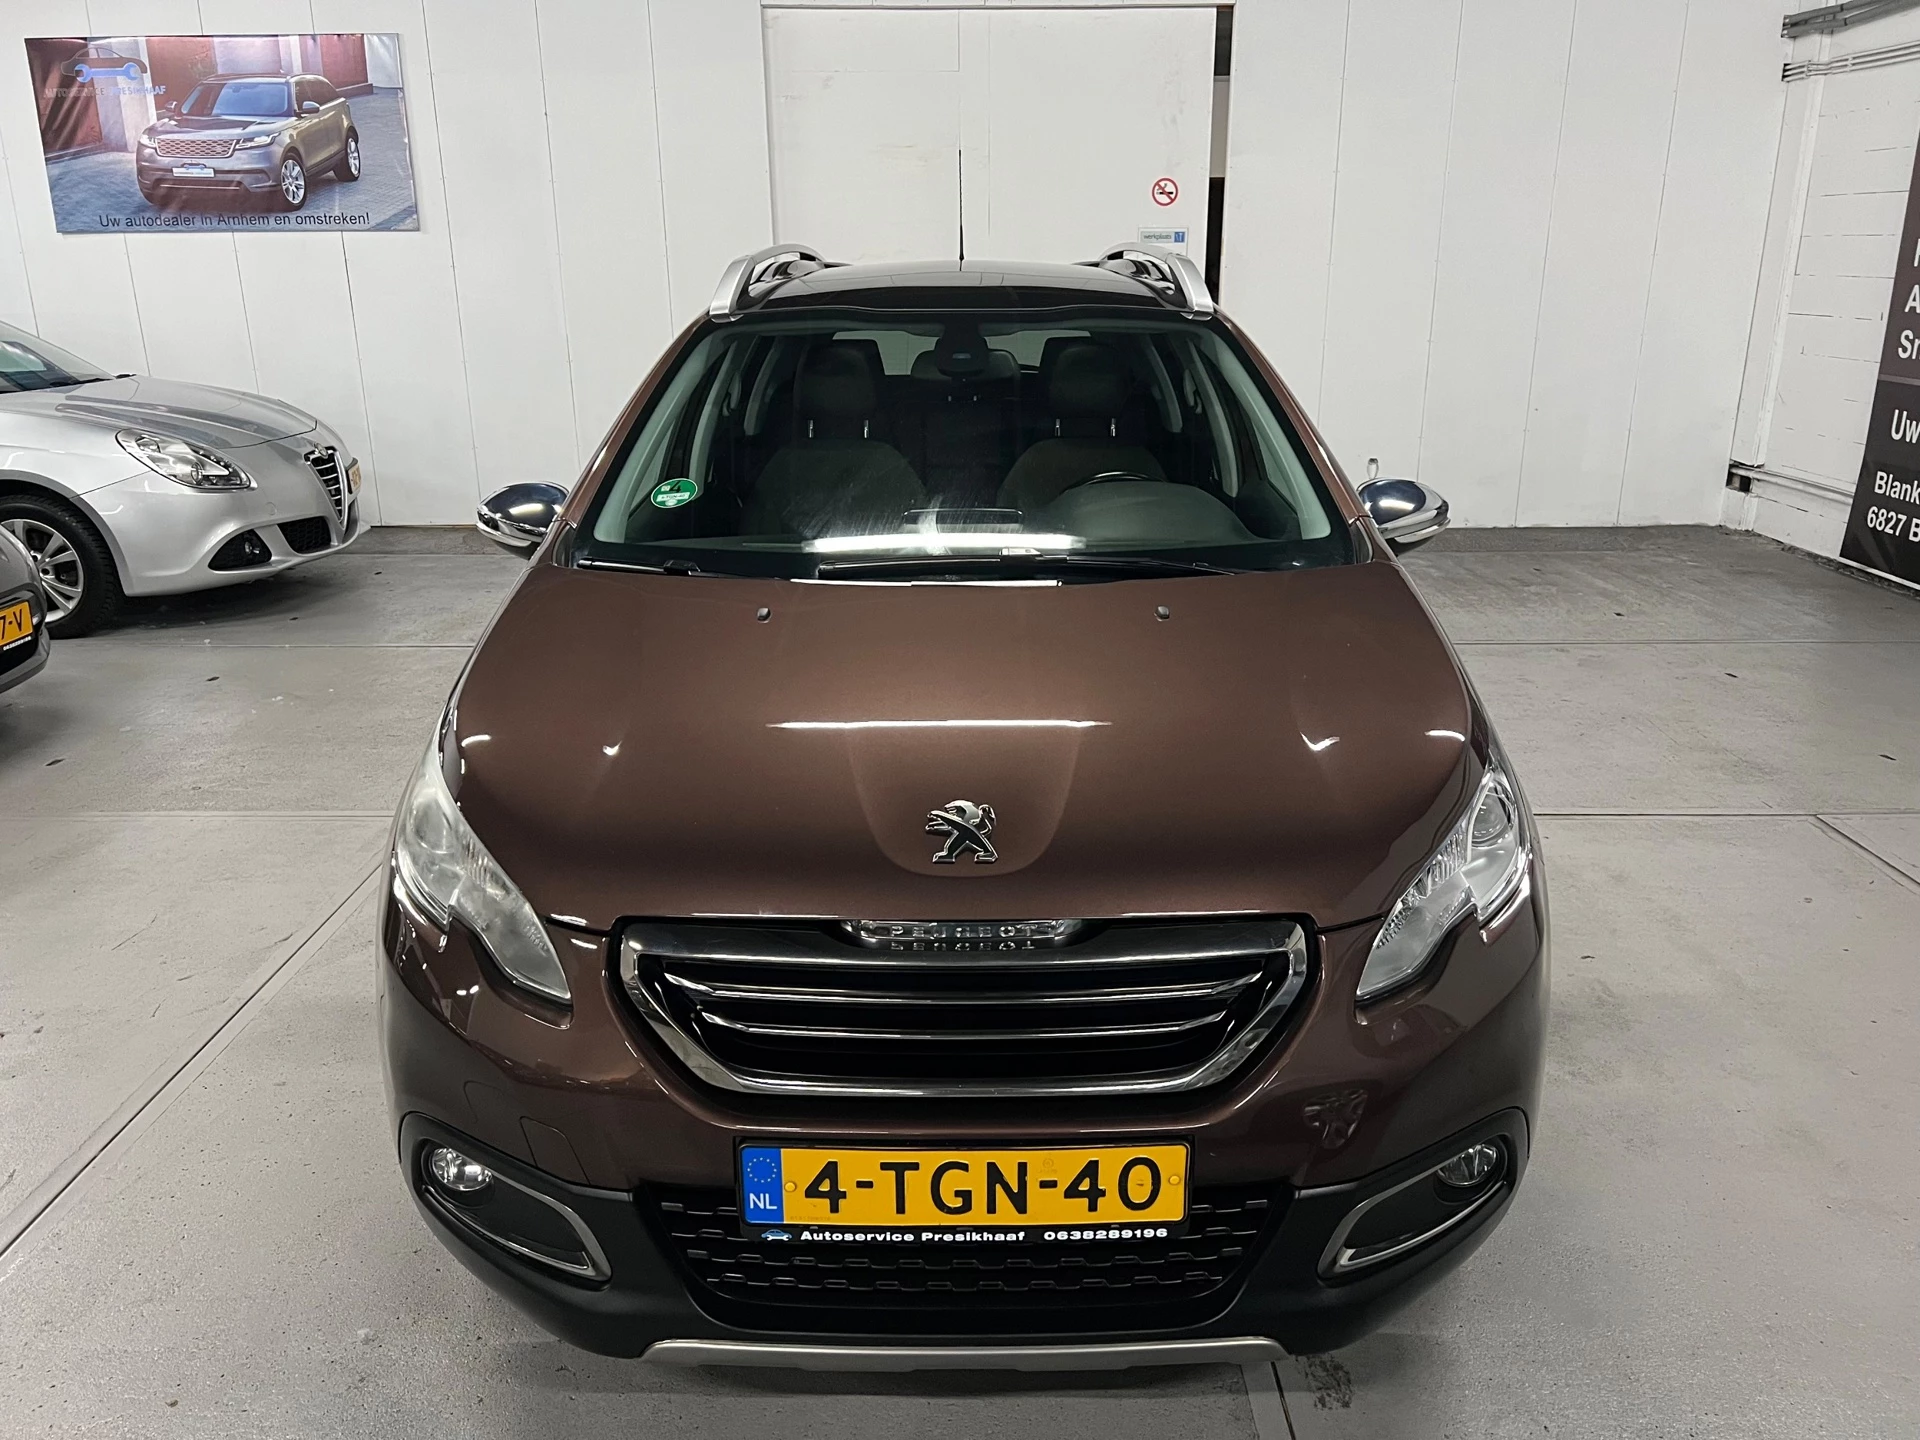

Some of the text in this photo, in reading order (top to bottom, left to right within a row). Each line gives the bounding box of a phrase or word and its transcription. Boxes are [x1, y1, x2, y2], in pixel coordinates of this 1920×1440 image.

[110, 85, 167, 97] RESIKHAAF
[99, 214, 121, 228] Uw
[125, 213, 196, 227] autodealer
[217, 212, 270, 226] Arnhem
[274, 215, 291, 226] en
[295, 212, 371, 225] omstreken!
[669, 480, 682, 493] 4
[1867, 506, 1907, 536] 6827
[890, 924, 1037, 938] PEUGEOT
[748, 1156, 1162, 1216] NL 4-TGN-40
[800, 1228, 1168, 1241] Autoservice Presikhaaf 0638289196
